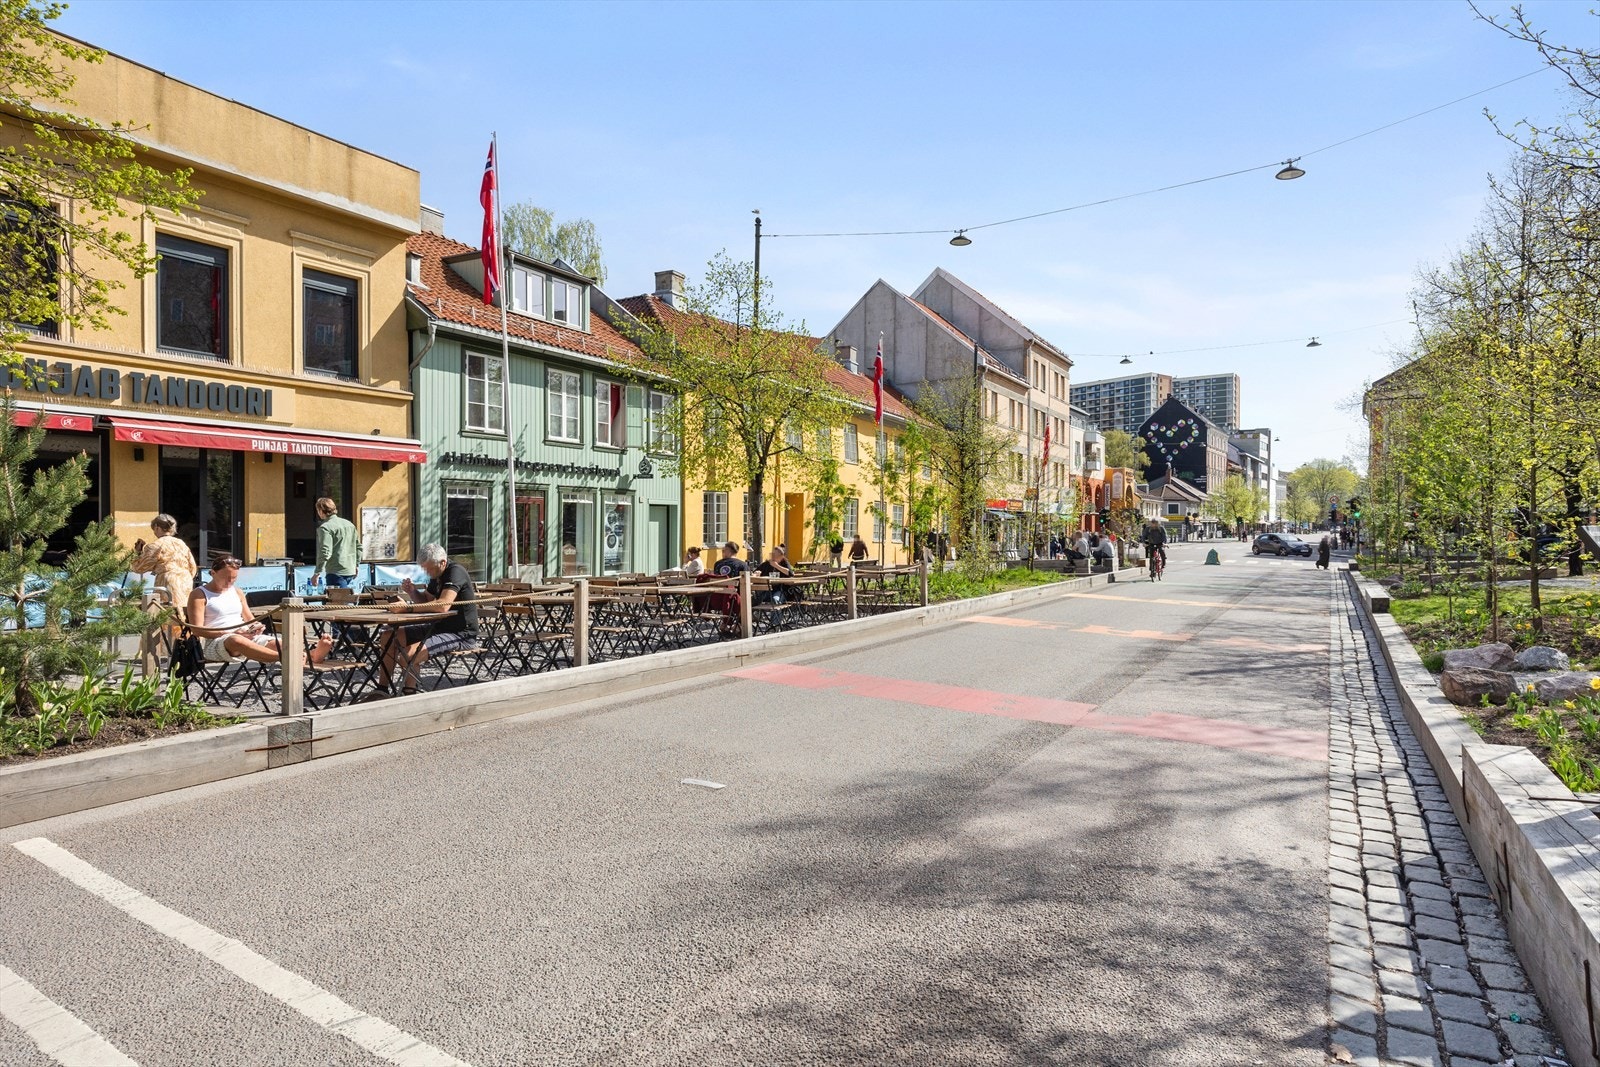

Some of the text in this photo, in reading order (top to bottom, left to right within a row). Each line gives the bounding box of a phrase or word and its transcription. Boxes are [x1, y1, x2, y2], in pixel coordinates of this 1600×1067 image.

[0, 357, 272, 416] UNJAB TANDOORI
[252, 439, 332, 456] PUNJAB TANDOORI
